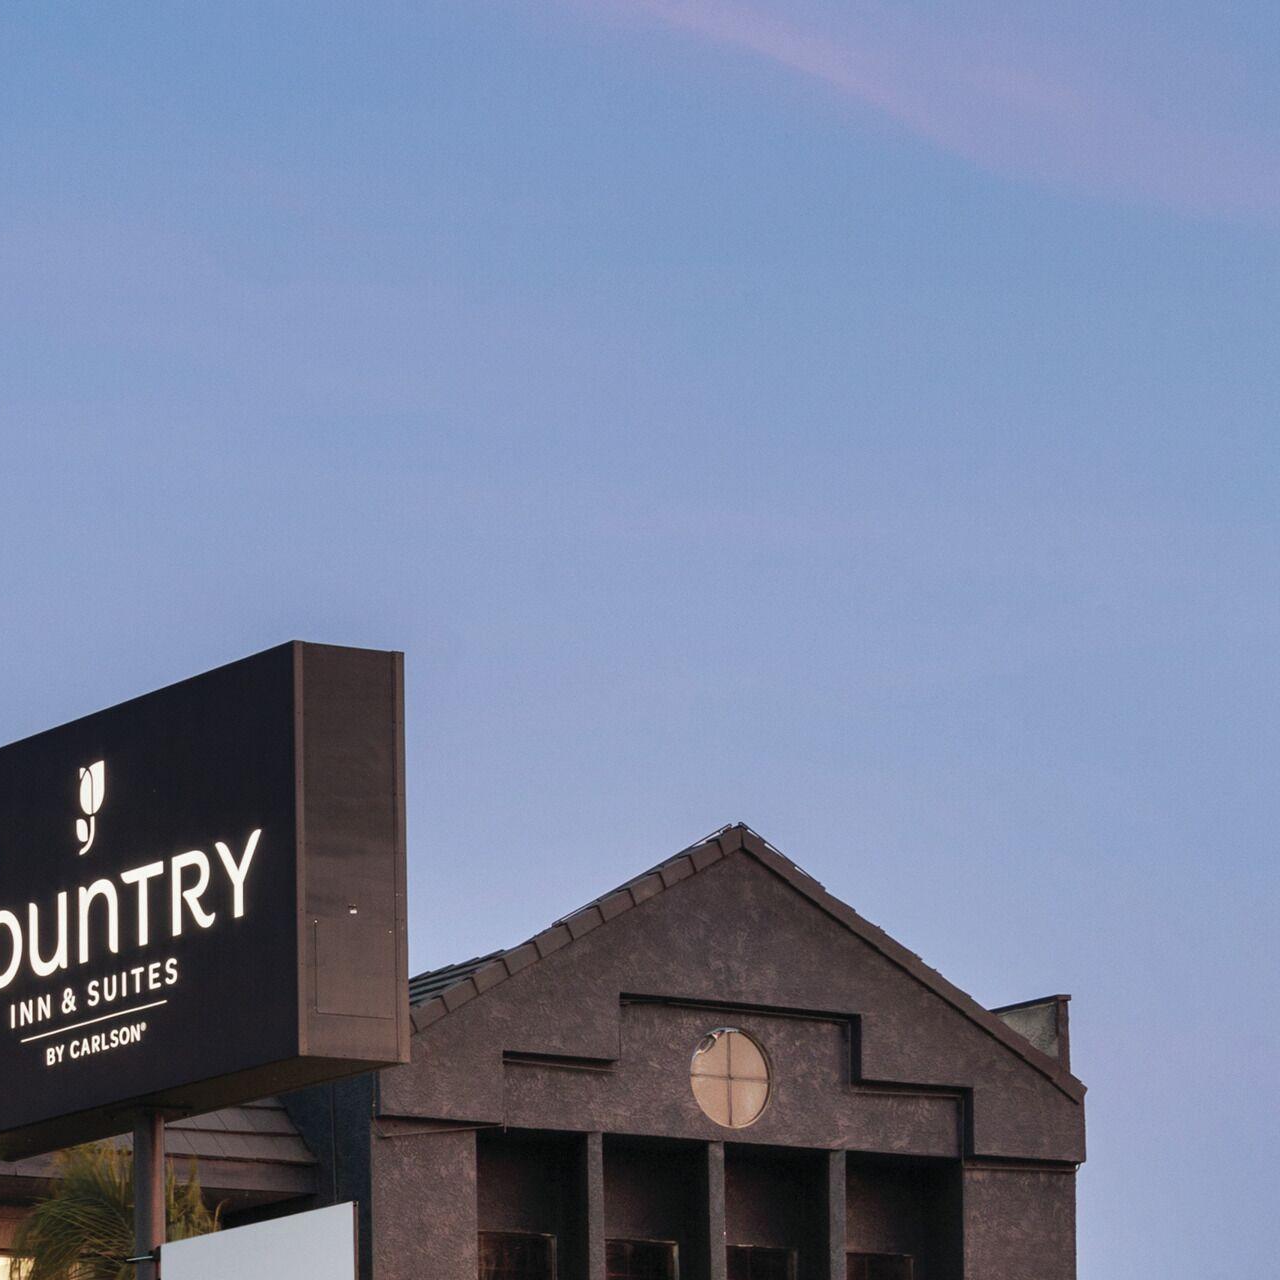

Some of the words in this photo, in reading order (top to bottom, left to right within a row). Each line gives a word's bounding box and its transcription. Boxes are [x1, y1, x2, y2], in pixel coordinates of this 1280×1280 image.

[9, 993, 52, 1030] INN
[60, 987, 78, 1015] &
[87, 957, 179, 1007] SUITES
[45, 1043, 65, 1067] BY
